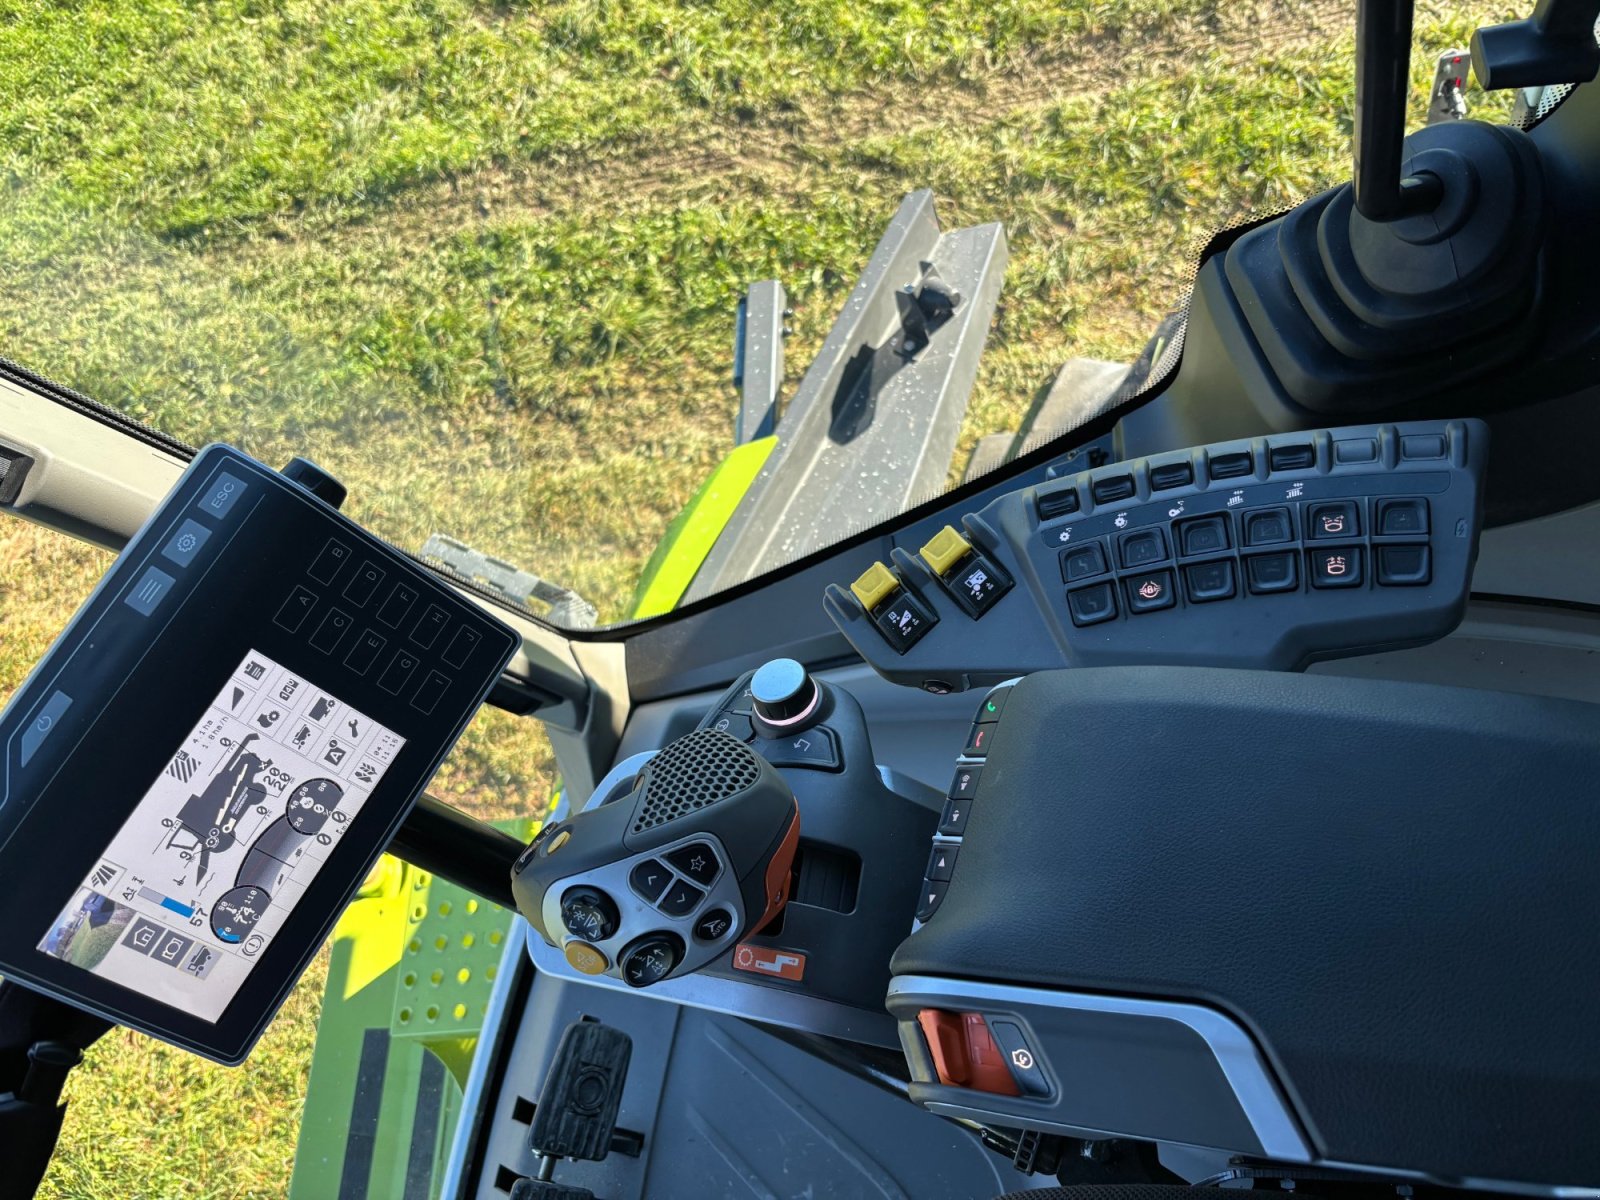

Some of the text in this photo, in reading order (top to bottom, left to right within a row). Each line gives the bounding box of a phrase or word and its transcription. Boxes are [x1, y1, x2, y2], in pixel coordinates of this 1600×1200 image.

[211, 481, 234, 508] ESC
[332, 547, 343, 557] B
[366, 570, 377, 580] D
[298, 594, 309, 605] A
[400, 592, 410, 600] F
[333, 617, 344, 627] C
[432, 612, 442, 622] H
[368, 637, 378, 646] E
[400, 658, 411, 668] G
[219, 736, 231, 747] 0
[262, 765, 281, 786] 20
[273, 771, 291, 791] 20
[256, 804, 267, 815] 0
[289, 799, 299, 810] 40
[313, 802, 325, 814] 0
[161, 816, 173, 828] 0
[293, 816, 303, 827] 20
[179, 850, 192, 861] 9
[244, 889, 257, 904] 110
[190, 906, 209, 928] 57
[235, 905, 255, 926] 74
[712, 921, 726, 936] AUTO
